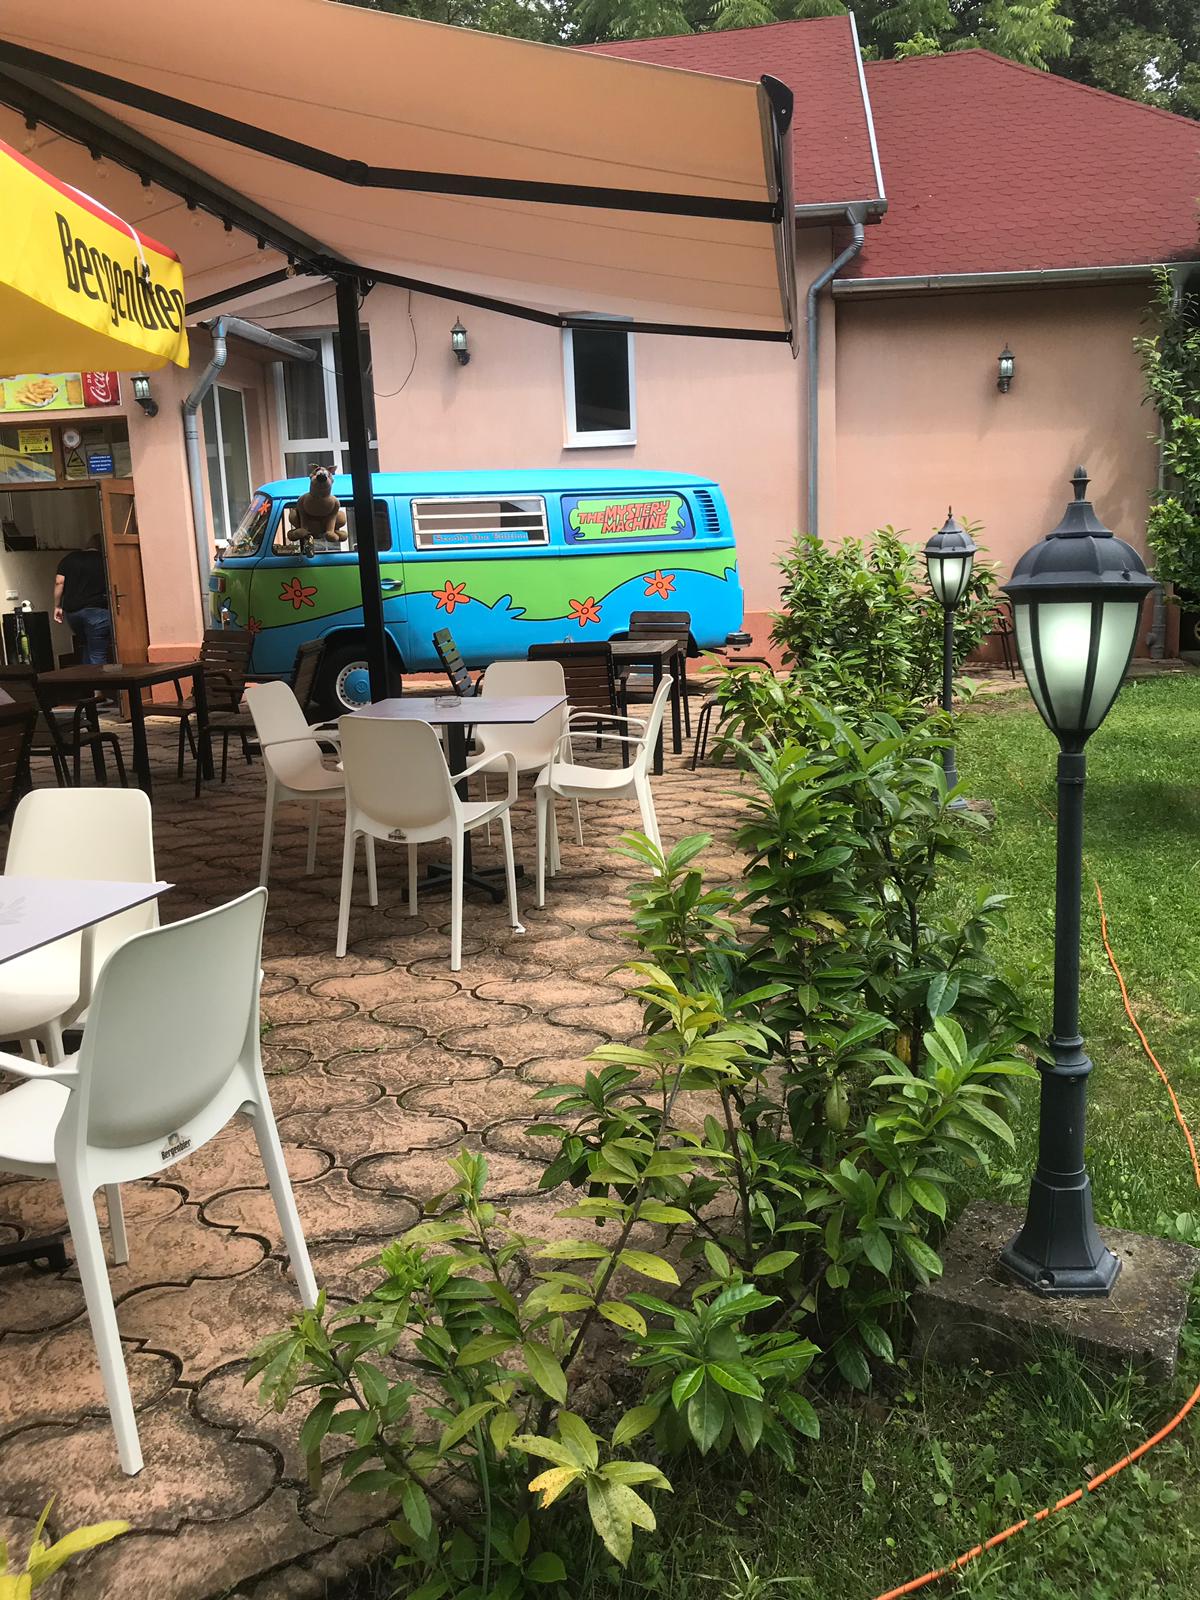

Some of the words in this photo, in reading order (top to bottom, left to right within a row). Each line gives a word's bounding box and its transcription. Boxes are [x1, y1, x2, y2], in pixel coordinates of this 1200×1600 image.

[578, 511, 605, 525] THE
[604, 500, 671, 522] MYSTERY
[601, 514, 667, 535] MACHINE
